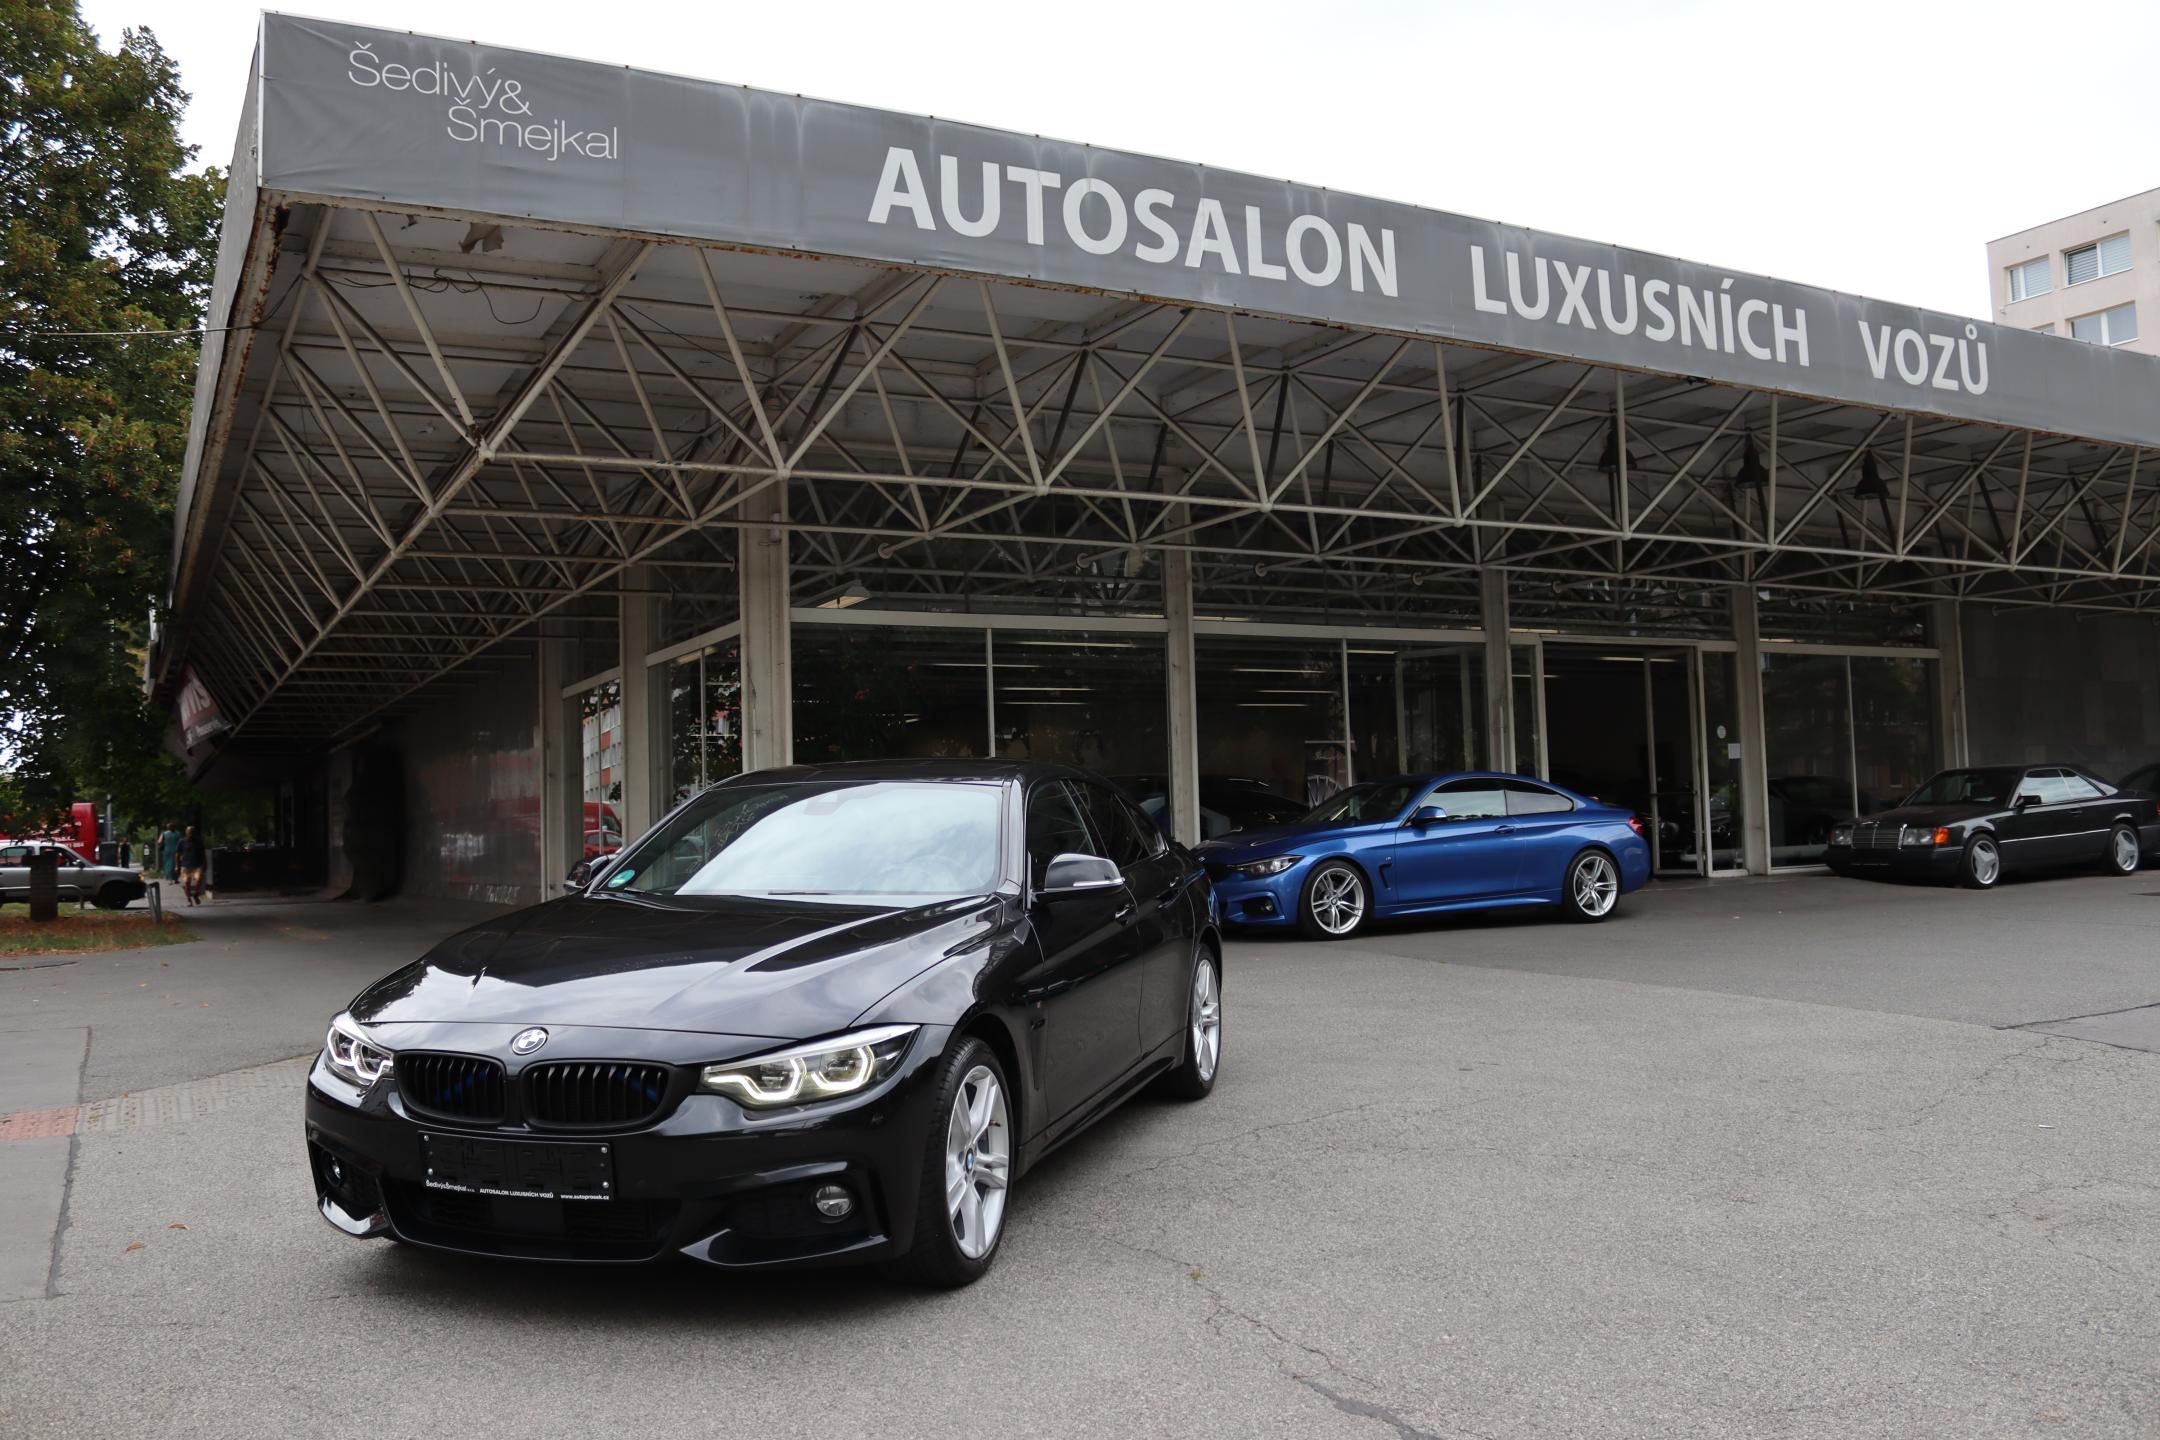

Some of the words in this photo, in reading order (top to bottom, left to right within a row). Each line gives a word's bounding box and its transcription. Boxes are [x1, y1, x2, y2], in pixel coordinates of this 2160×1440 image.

[446, 97, 618, 161] Šmejkal
[868, 146, 1398, 298] AUTOSALON
[1470, 245, 1810, 367] LUXUSNÍCH
[1858, 320, 1990, 396] VOZŮ
[479, 1188, 509, 1196] AUTOSALON
[509, 1190, 539, 1198] LUXUSNÍCH
